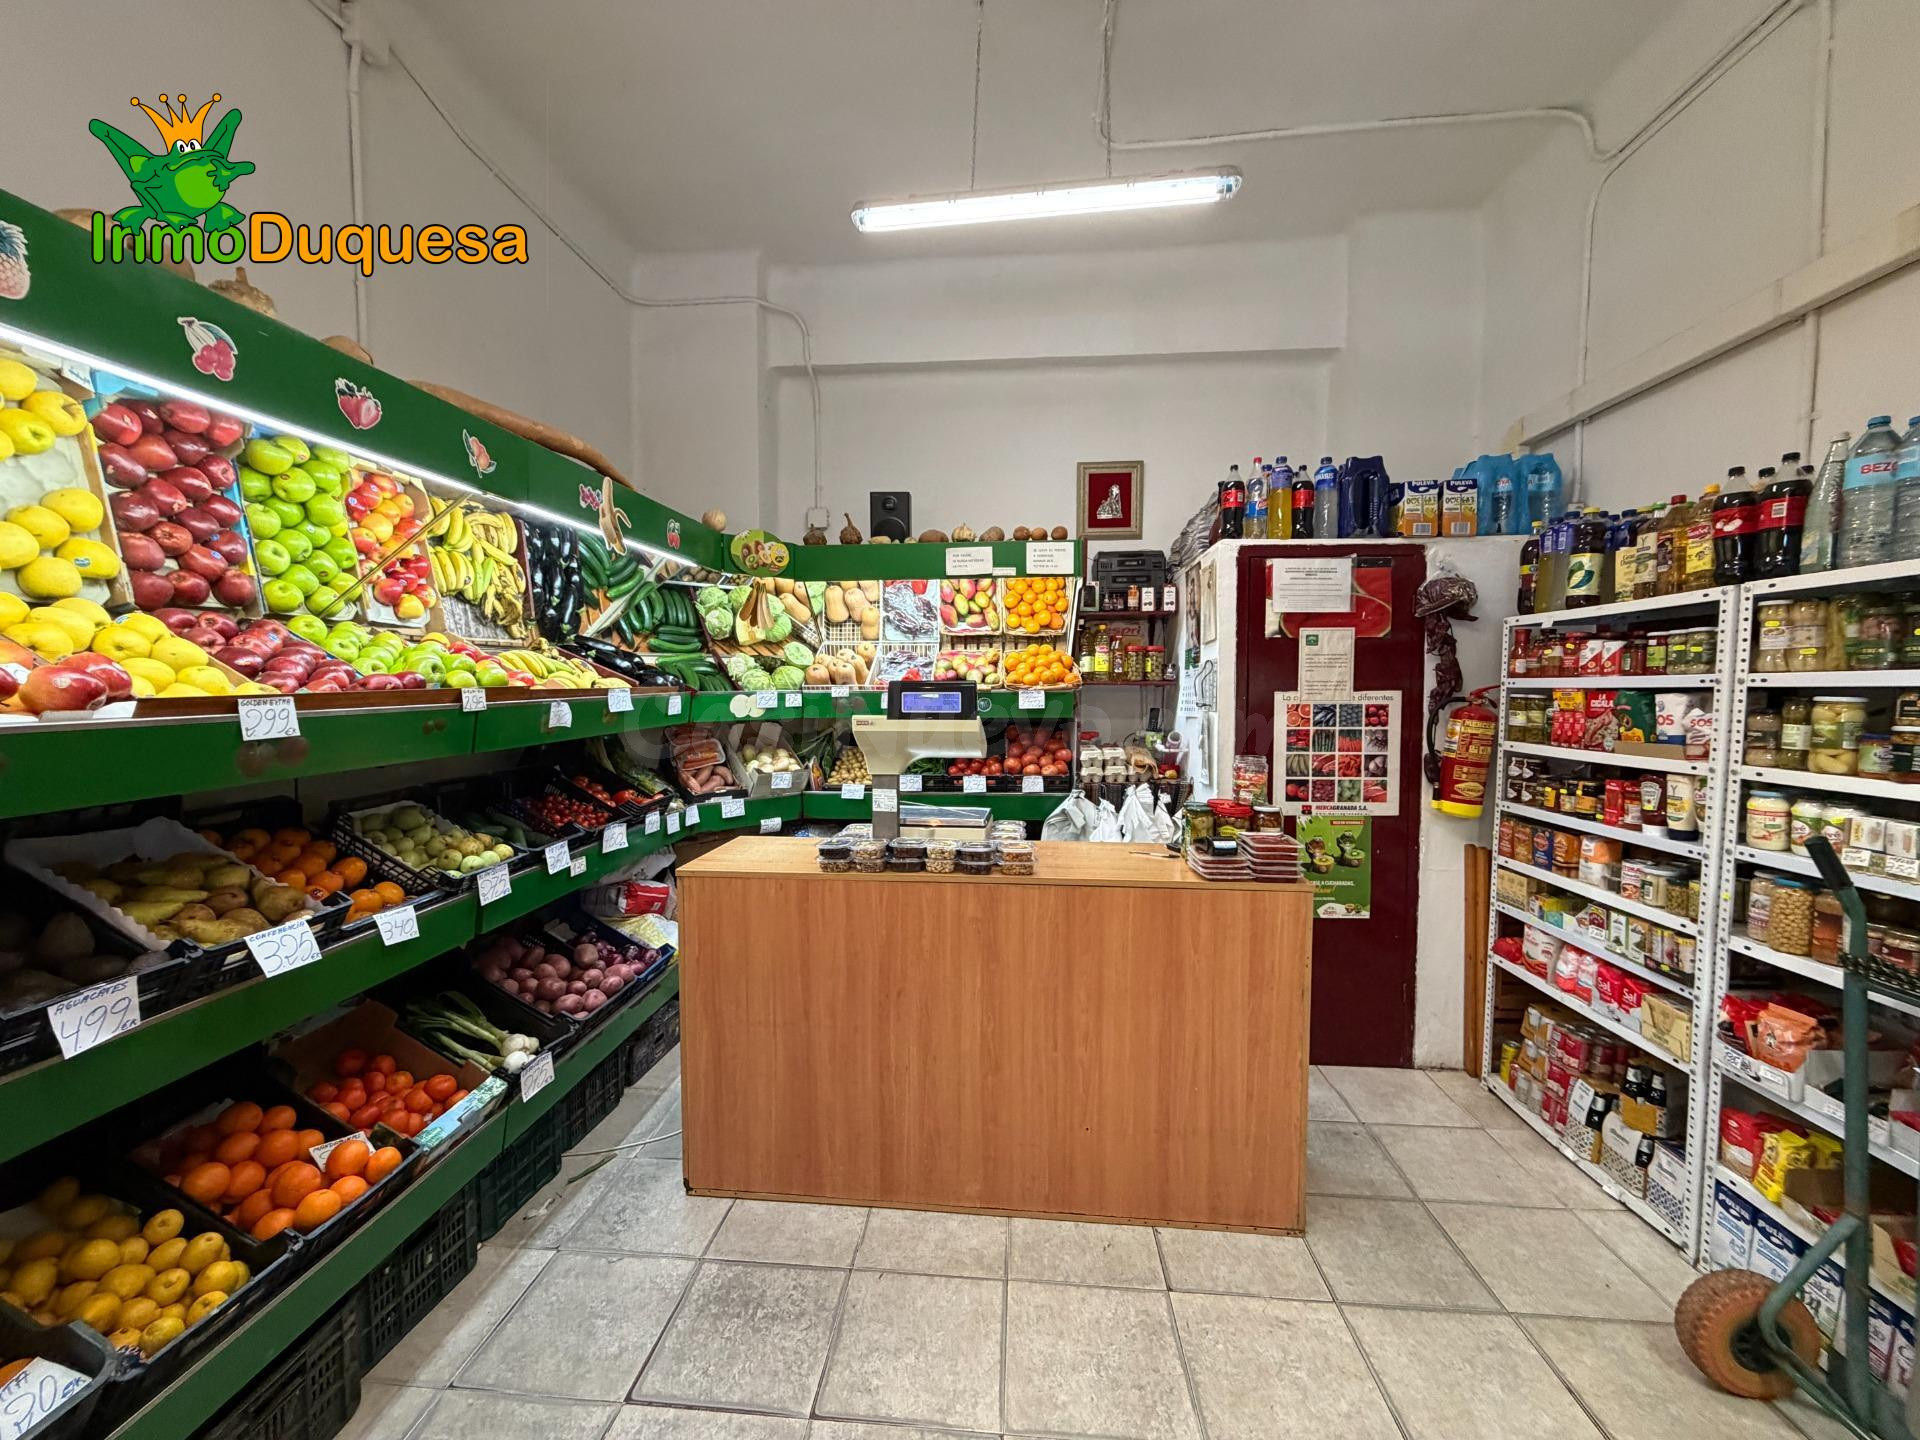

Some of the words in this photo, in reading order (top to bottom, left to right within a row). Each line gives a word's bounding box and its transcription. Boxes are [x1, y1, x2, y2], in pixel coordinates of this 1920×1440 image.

[1357, 693, 1394, 701] diferentes
[249, 921, 306, 942] CONFERENCIA
[54, 981, 128, 1016] AGUACATES
[1623, 988, 1637, 1004] Sal
